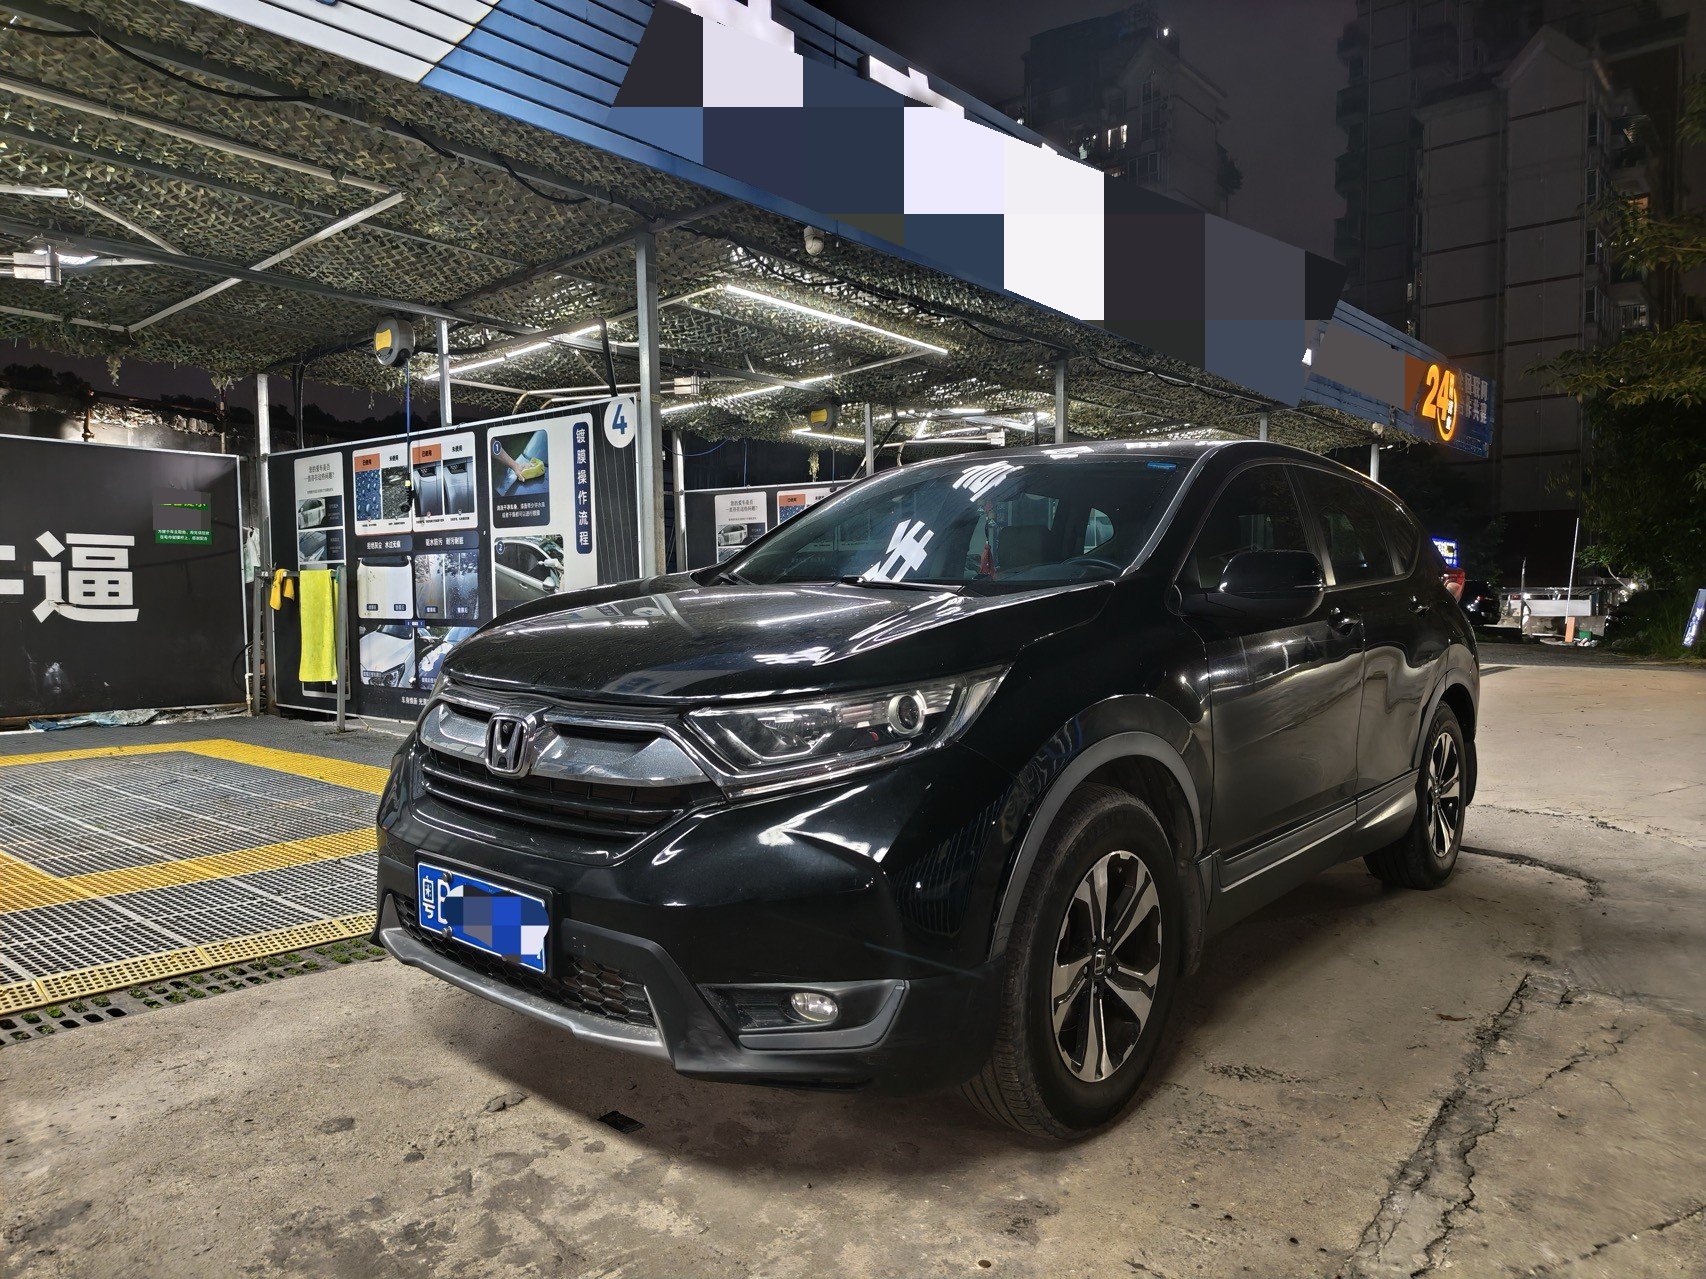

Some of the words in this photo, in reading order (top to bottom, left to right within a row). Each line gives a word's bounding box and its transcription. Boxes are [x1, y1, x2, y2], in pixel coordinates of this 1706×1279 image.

[611, 404, 628, 435] 4
[1422, 364, 1455, 421] 24
[576, 429, 589, 546] 镀膜操作流程
